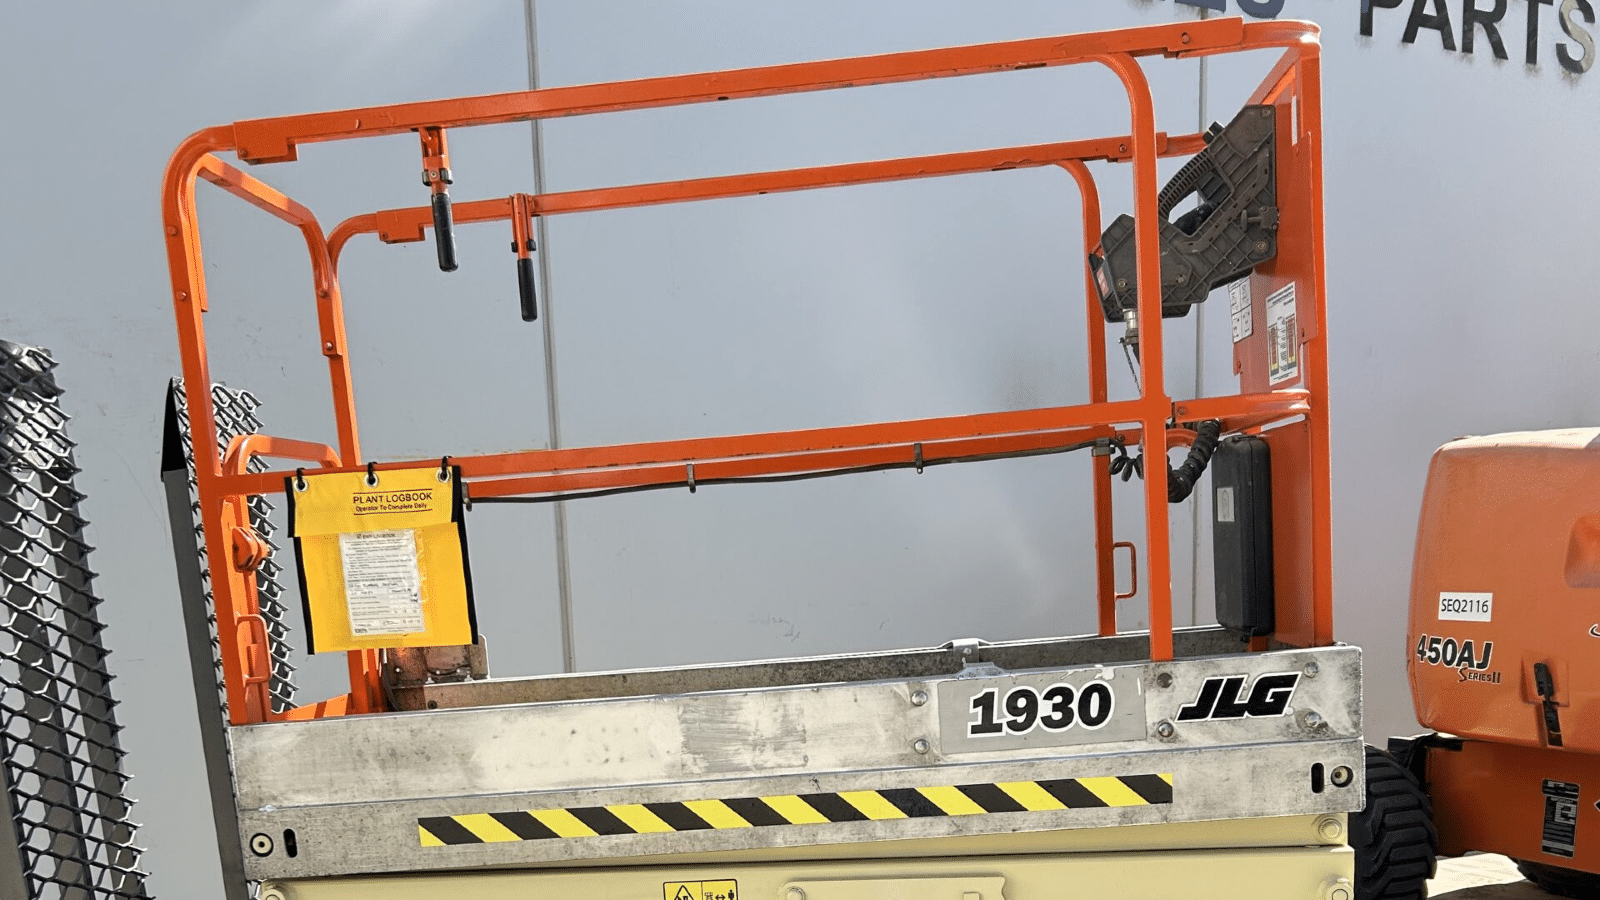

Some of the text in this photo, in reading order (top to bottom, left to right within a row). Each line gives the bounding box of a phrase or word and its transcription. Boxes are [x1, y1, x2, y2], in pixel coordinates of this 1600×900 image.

[353, 492, 433, 504] PLANT LOGBOOK
[355, 505, 378, 513] Operator
[388, 503, 413, 511] Complete
[414, 502, 428, 510] Daily
[1441, 598, 1489, 614] SEQ2116
[1416, 633, 1494, 671] 450AJ
[969, 680, 1114, 736] 1930
[1178, 673, 1301, 722] JLG
